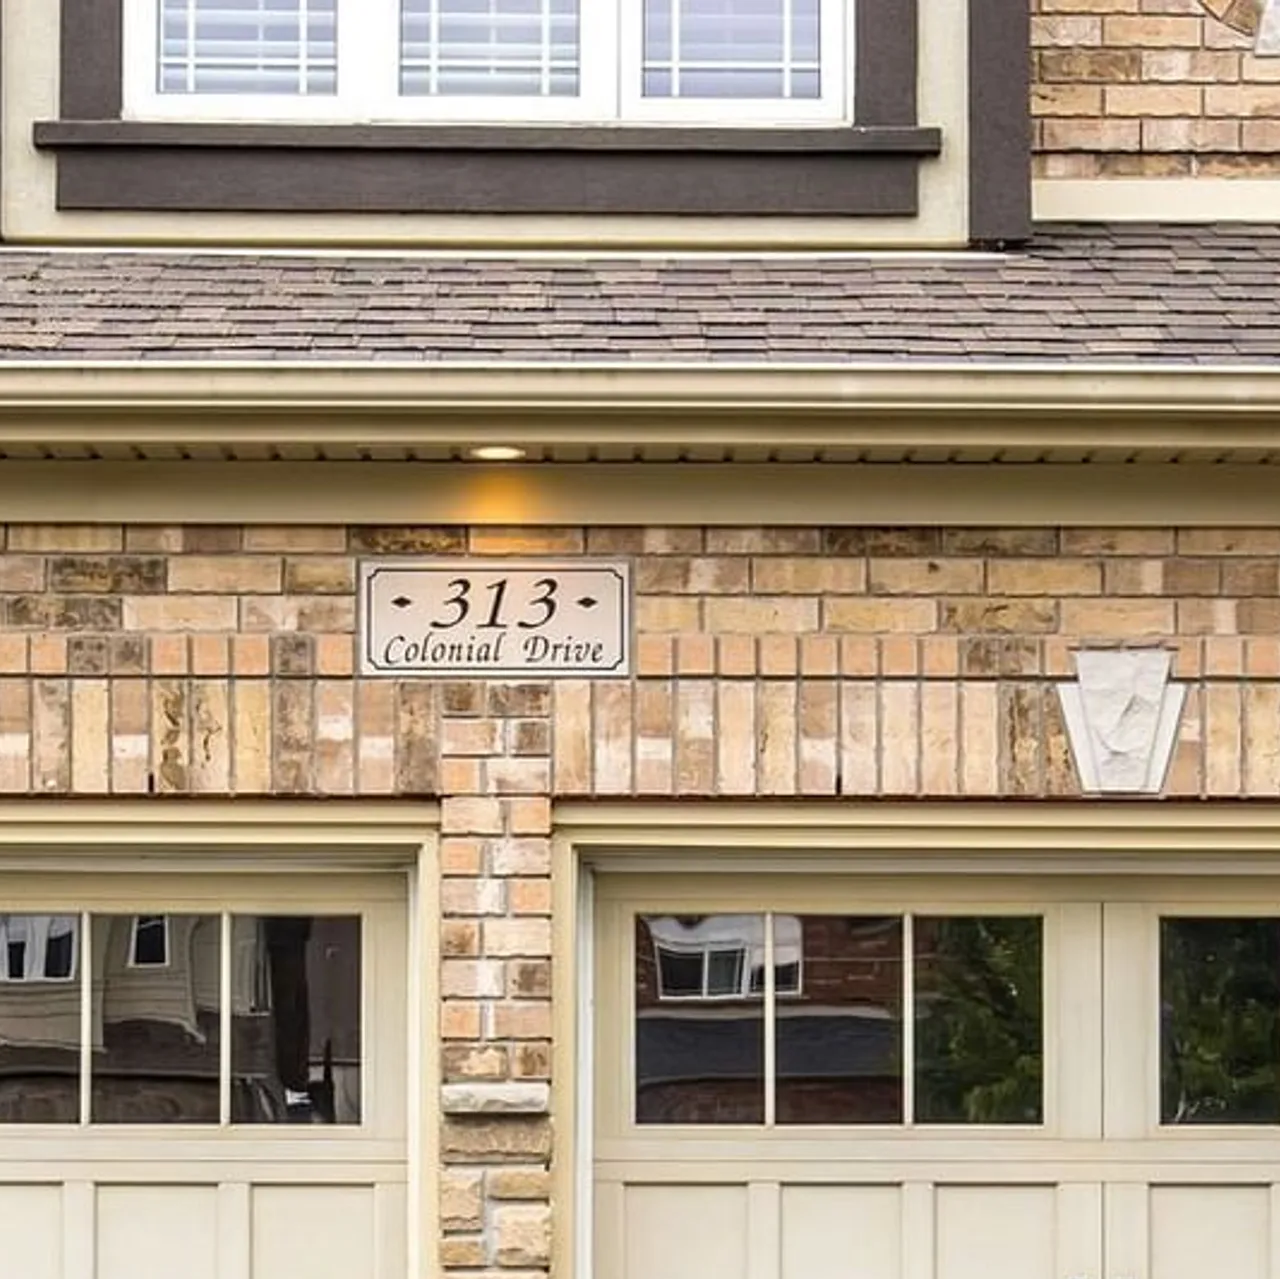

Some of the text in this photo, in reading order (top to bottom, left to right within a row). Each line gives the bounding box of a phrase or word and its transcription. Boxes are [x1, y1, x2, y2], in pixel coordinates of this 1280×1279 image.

[429, 578, 558, 629] 313
[383, 631, 604, 665] Colonial Drive
